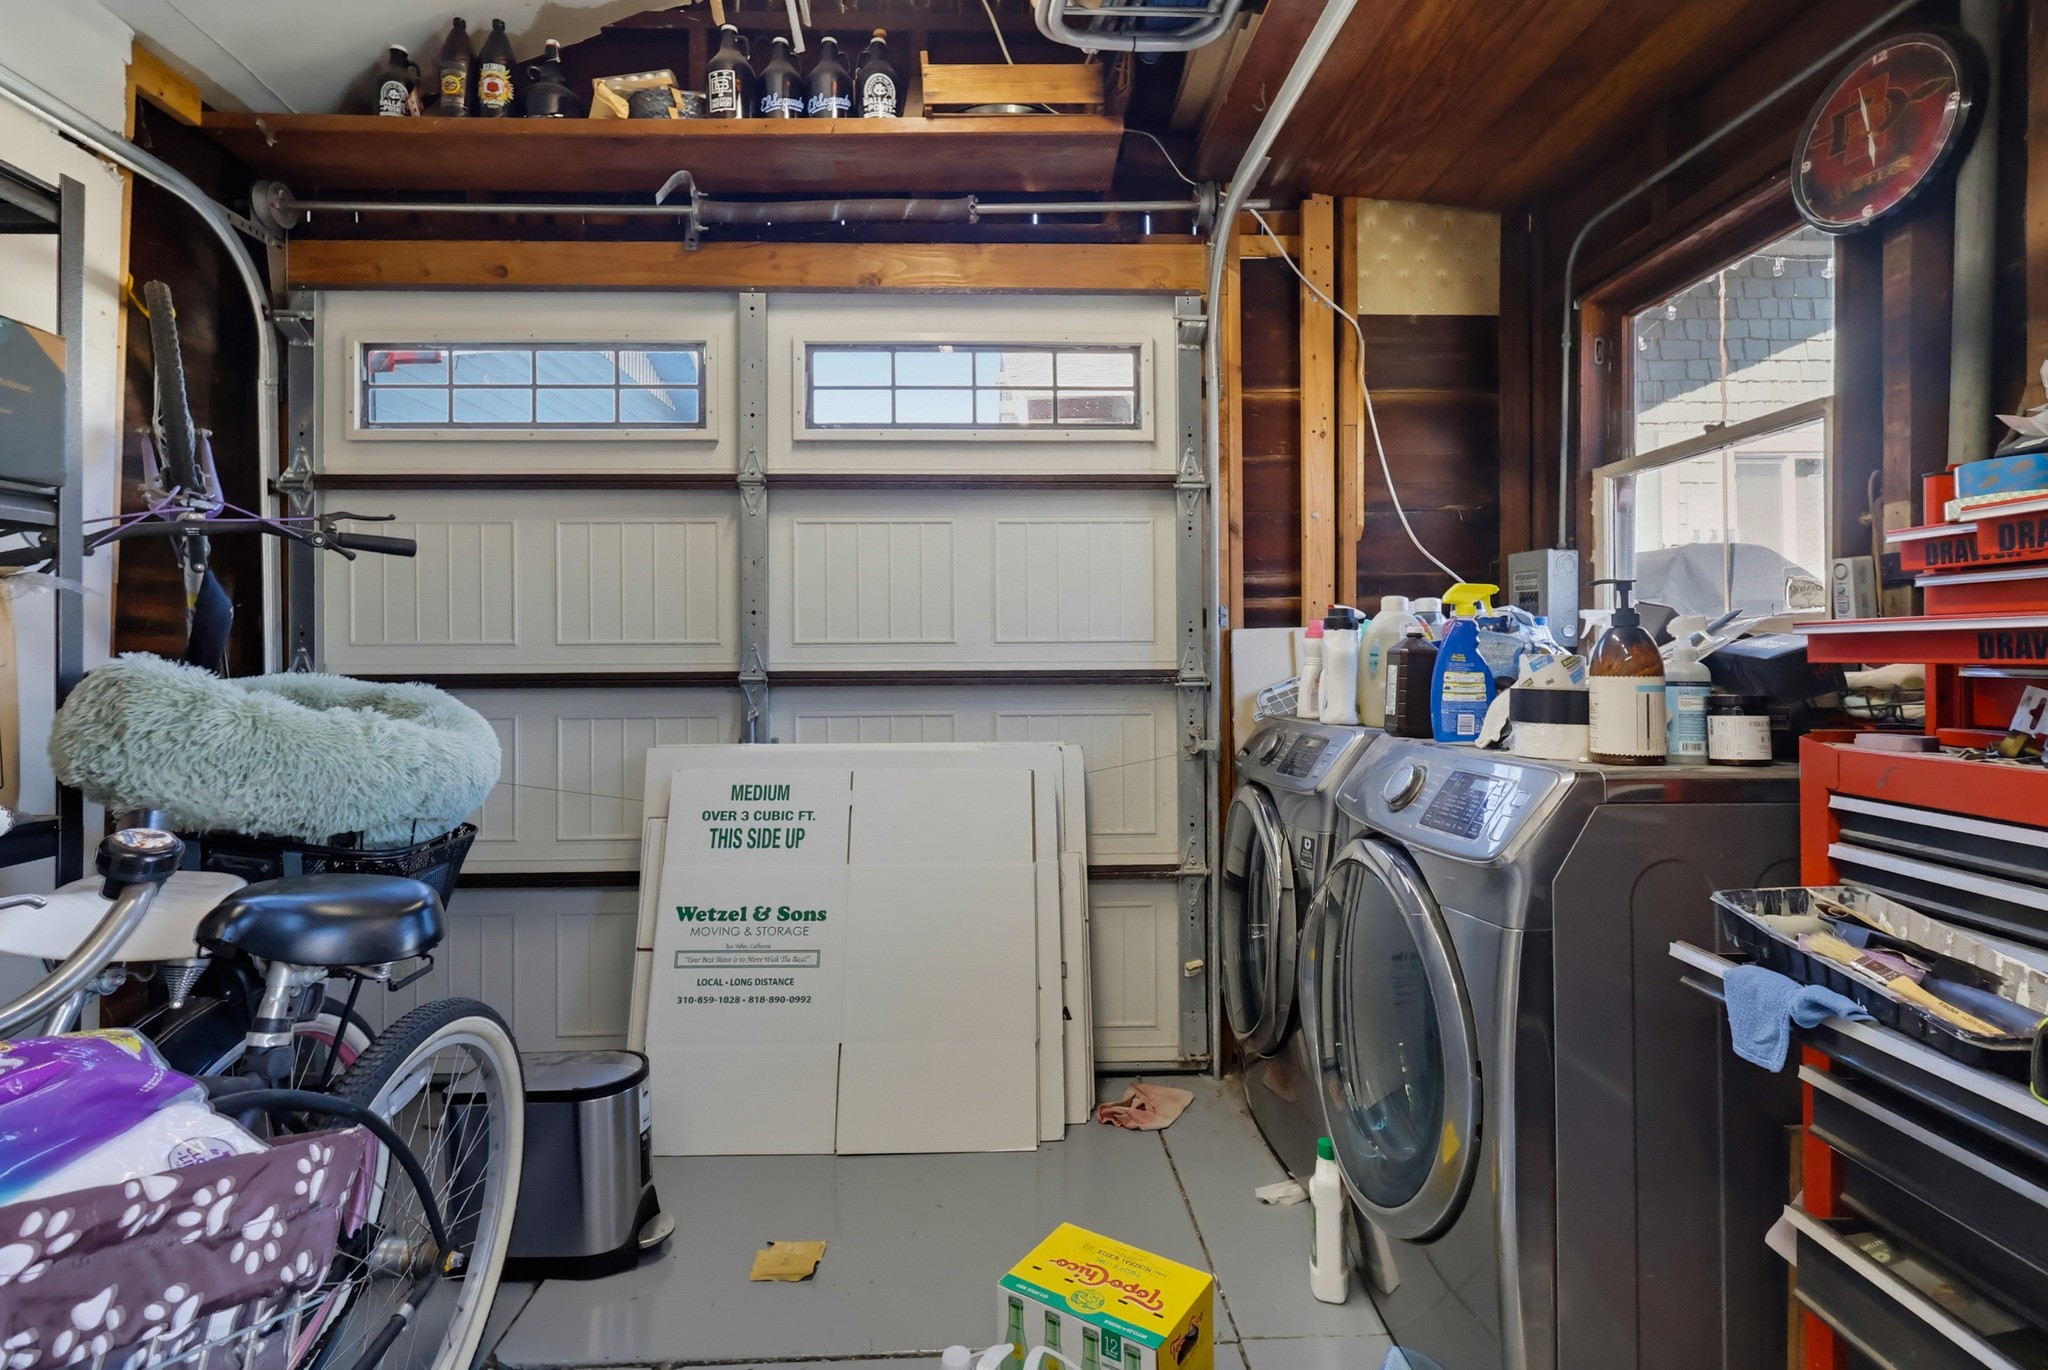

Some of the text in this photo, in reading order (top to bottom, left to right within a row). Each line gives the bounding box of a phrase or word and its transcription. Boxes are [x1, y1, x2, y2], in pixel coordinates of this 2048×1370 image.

[1872, 50, 1888, 67] 12
[863, 97, 897, 107] BALLAST
[867, 105, 893, 113] POINT
[1801, 160, 1812, 173] 9
[1861, 204, 1874, 218] 6
[731, 784, 791, 801] MEDIUM
[701, 810, 816, 822] OVER 3 CUBIC FT.
[709, 827, 806, 849] THIS SIDE UP
[675, 905, 827, 922] Wetzel & Sons
[690, 926, 809, 937] MOVING & STORAGE
[746, 956, 761, 964] Move
[696, 977, 795, 987] LOCAL LONG DISTANCE
[676, 995, 812, 1004] 310-859-1028 818-890-0992
[1049, 1257, 1109, 1287] Chico
[1105, 1279, 1165, 1312] Topo
[1104, 1336, 1118, 1356] 12
